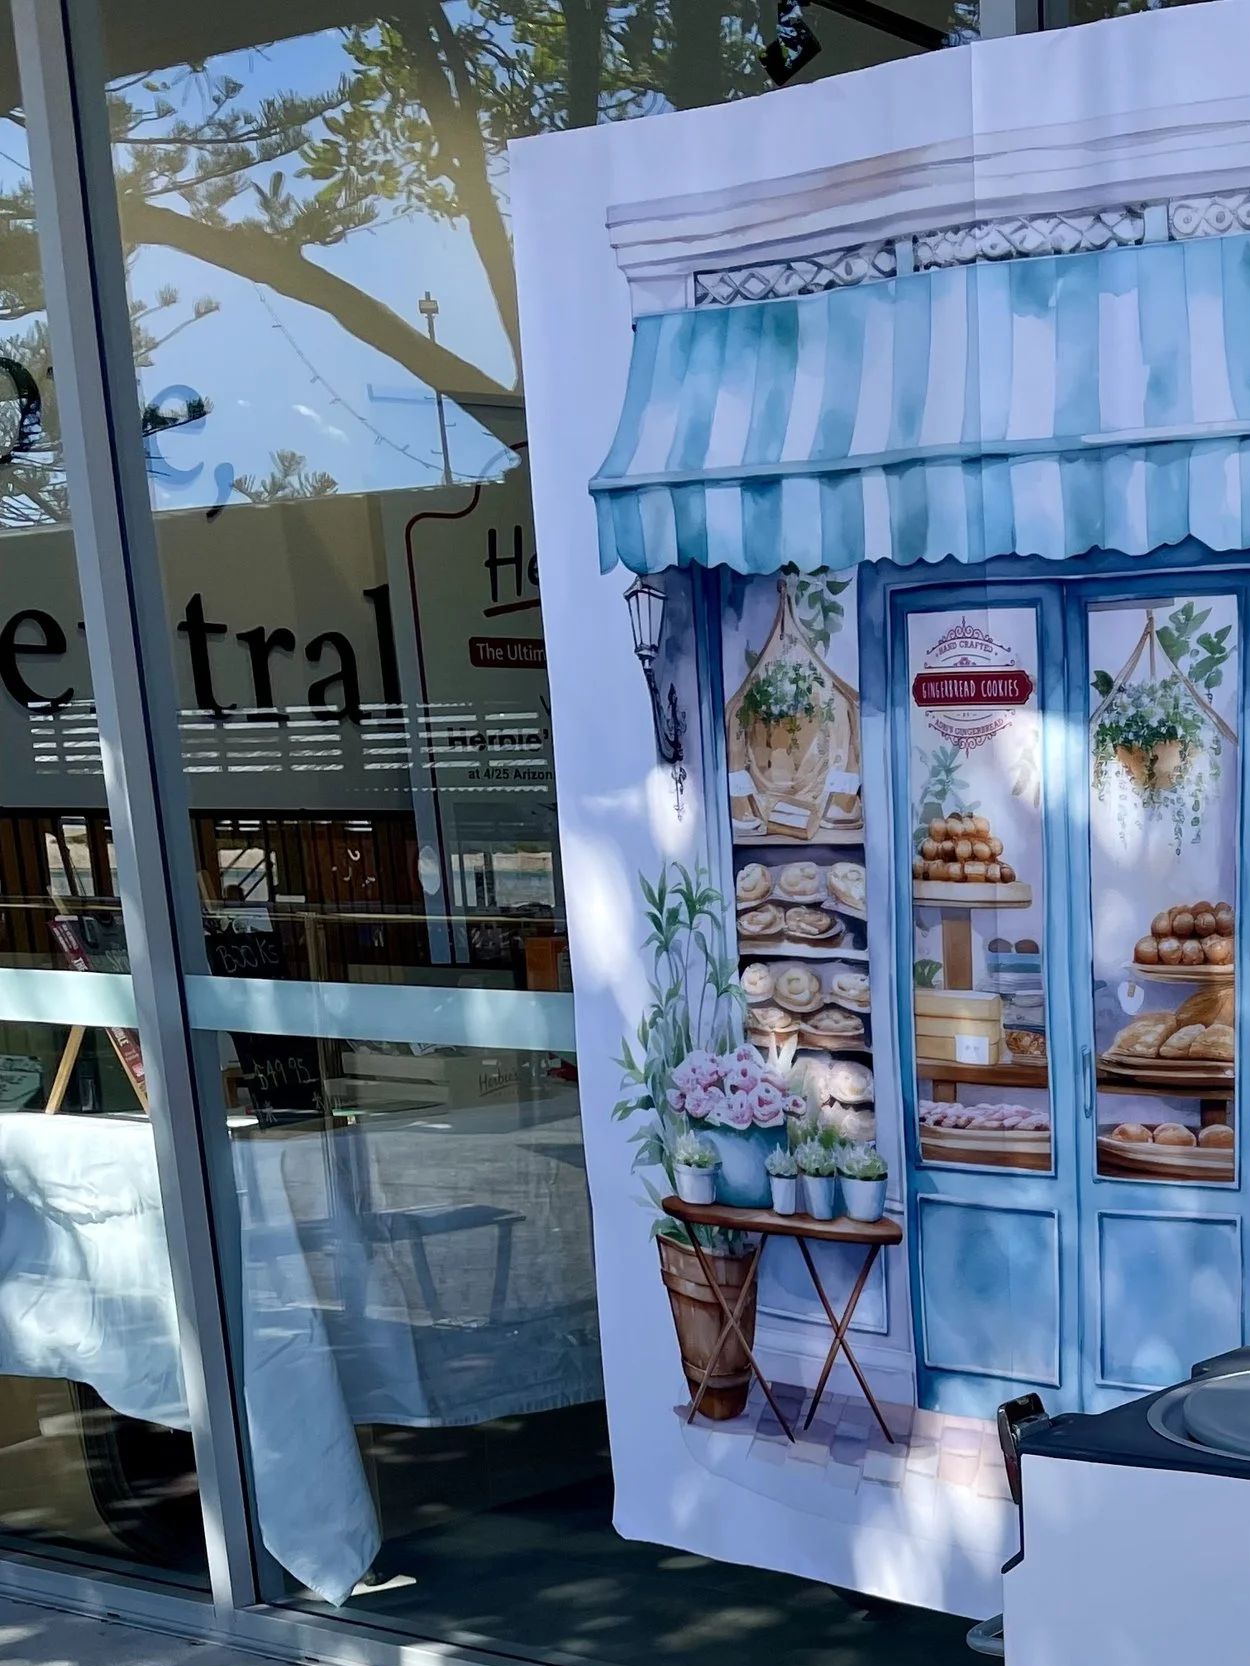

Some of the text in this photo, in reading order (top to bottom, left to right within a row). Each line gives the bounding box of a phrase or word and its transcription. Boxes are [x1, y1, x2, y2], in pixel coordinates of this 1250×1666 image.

[476, 643, 504, 661] The
[938, 640, 994, 655] HAND CRAFTED
[922, 679, 1019, 699] GINGERBREAD COOKIES
[468, 769, 480, 780] at
